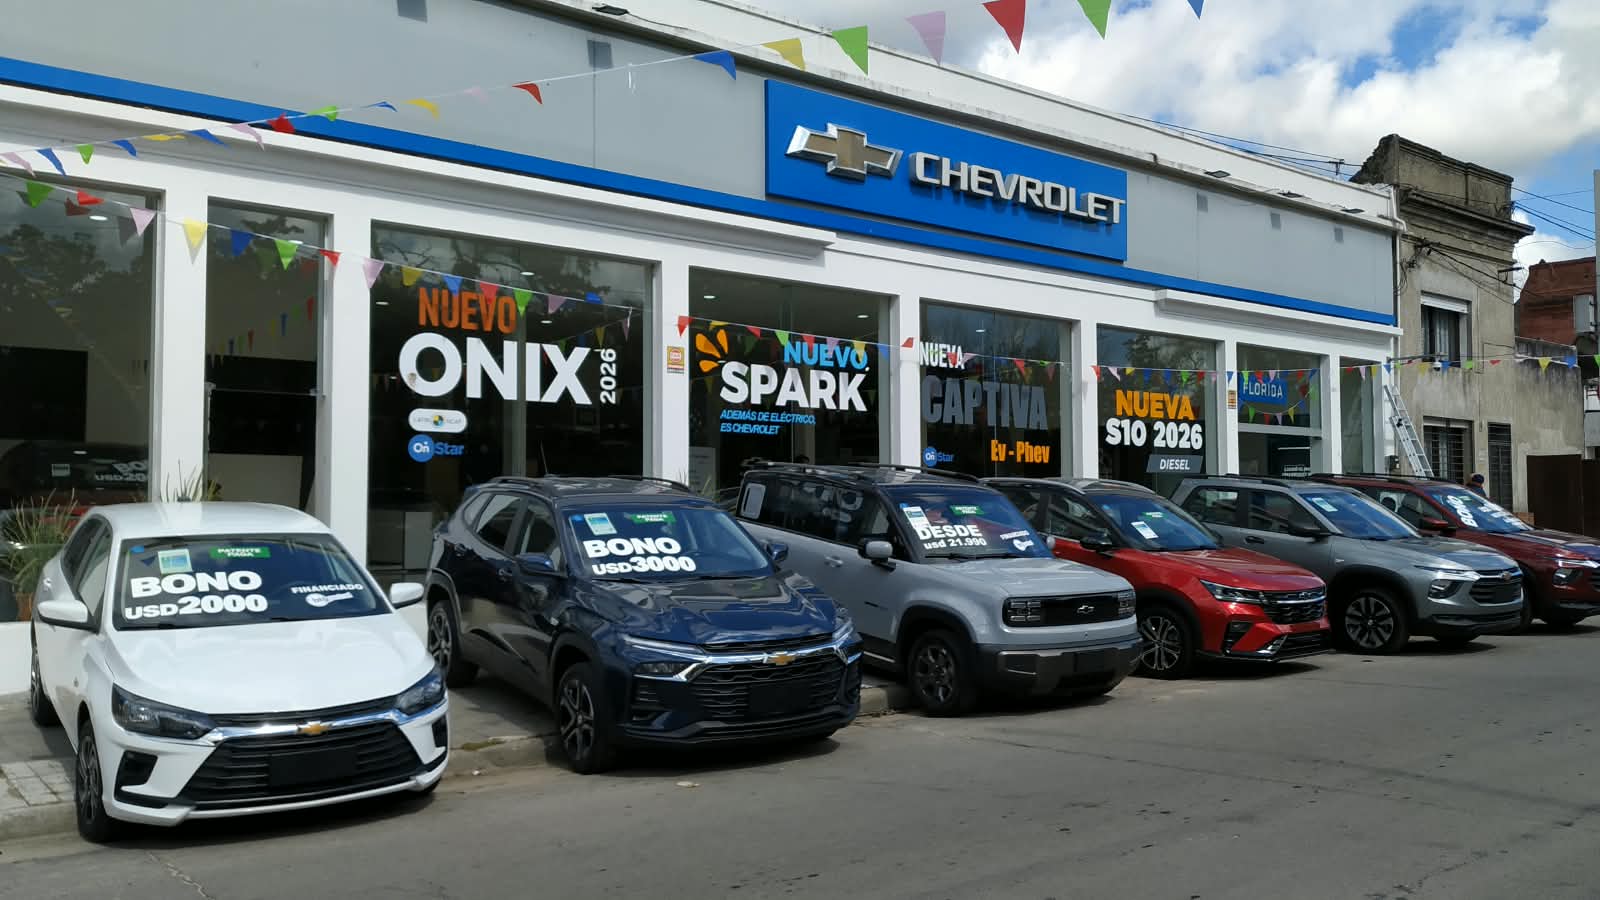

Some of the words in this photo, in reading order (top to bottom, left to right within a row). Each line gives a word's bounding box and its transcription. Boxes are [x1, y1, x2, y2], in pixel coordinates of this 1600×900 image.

[910, 151, 1126, 225] CHEVROLET
[418, 287, 516, 334] NUEVO
[399, 332, 592, 405] ONIX
[784, 339, 868, 370] NUEVO
[920, 341, 965, 370] NUEVA
[600, 348, 617, 405] 2026
[720, 361, 867, 412] SPARK
[1243, 382, 1283, 399] FLORIDA
[720, 409, 757, 421] ADEMÁS
[757, 412, 769, 422] DE
[922, 375, 1048, 430] CAPTIVA
[1115, 389, 1196, 420] NUEVA
[720, 422, 732, 432] ES
[732, 423, 780, 435] CHEVROLET
[1105, 418, 1147, 447] S10
[1153, 421, 1203, 449] 2026
[991, 440, 1006, 461] Ev
[1016, 441, 1050, 463] Phev
[1159, 458, 1191, 470] DIESEL
[915, 525, 983, 540] DESDE
[923, 538, 946, 549] usd
[949, 537, 987, 546] 21.990
[583, 537, 681, 558] BONO
[131, 571, 262, 598] BONO
[291, 584, 364, 593] FINANCIADO
